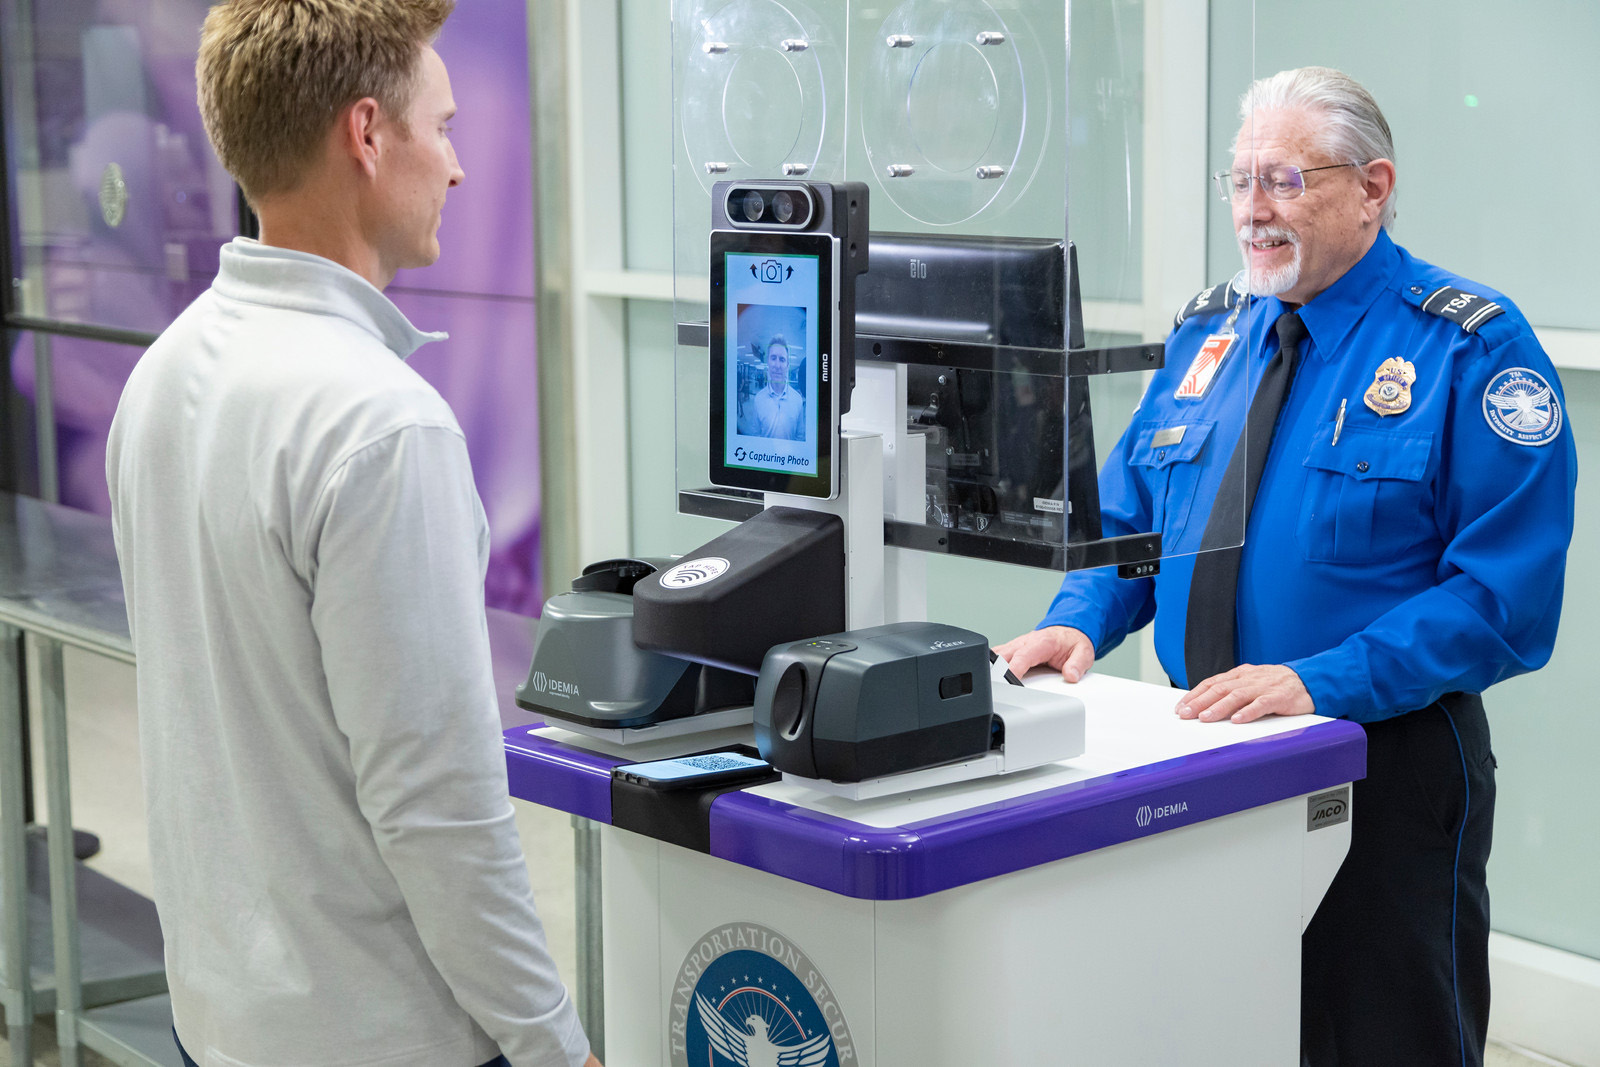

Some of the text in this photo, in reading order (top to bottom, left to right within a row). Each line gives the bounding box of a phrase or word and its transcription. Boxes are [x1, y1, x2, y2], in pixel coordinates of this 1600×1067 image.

[1440, 293, 1478, 314] TSA
[748, 450, 810, 466] Capturing Photo
[548, 678, 580, 697] IDEMIA
[1153, 801, 1188, 819] IDEMIA
[1311, 804, 1342, 821] JACO
[672, 927, 801, 1056] TRANSPORTATION
